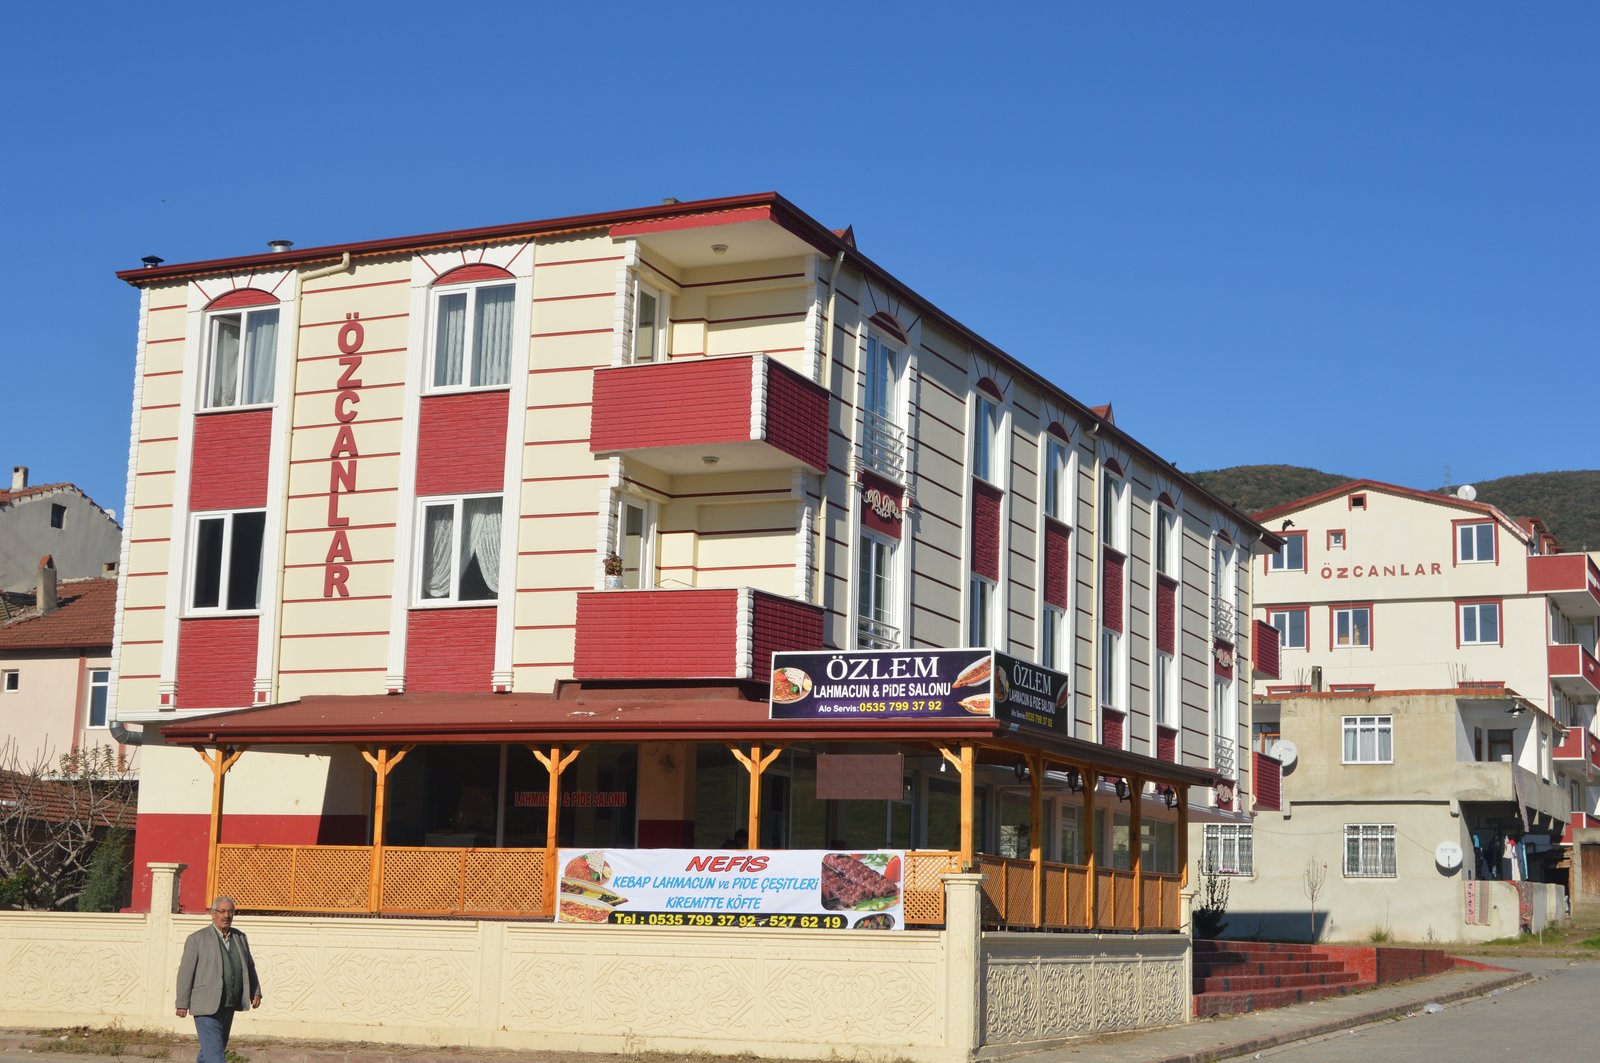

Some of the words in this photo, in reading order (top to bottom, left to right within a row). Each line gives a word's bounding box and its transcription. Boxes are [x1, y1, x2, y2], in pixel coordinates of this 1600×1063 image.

[323, 311, 366, 598] ÖZCANLAR
[1320, 562, 1442, 580] ÖZCANLAR
[826, 655, 940, 680] ÖZLEM
[1013, 660, 1052, 696] ÖZLEM
[813, 684, 870, 698] LAHMACUN
[872, 684, 880, 698] &
[908, 682, 951, 697] SALONU
[818, 704, 832, 713] Alo
[889, 701, 909, 711] 799
[912, 701, 926, 711] 37
[928, 700, 942, 710] 92
[563, 792, 571, 807] &
[592, 792, 628, 807] SALONU
[612, 876, 652, 889] KEBAP
[652, 876, 717, 889] LAHMACUN
[718, 880, 729, 890] ve
[726, 894, 762, 909] KÖFTE
[648, 913, 684, 926] 0535
[687, 914, 714, 926] 799
[717, 915, 735, 927] 37
[739, 915, 756, 927] 92
[769, 915, 797, 928] 527
[800, 916, 819, 928] 62
[823, 916, 841, 928] 19
